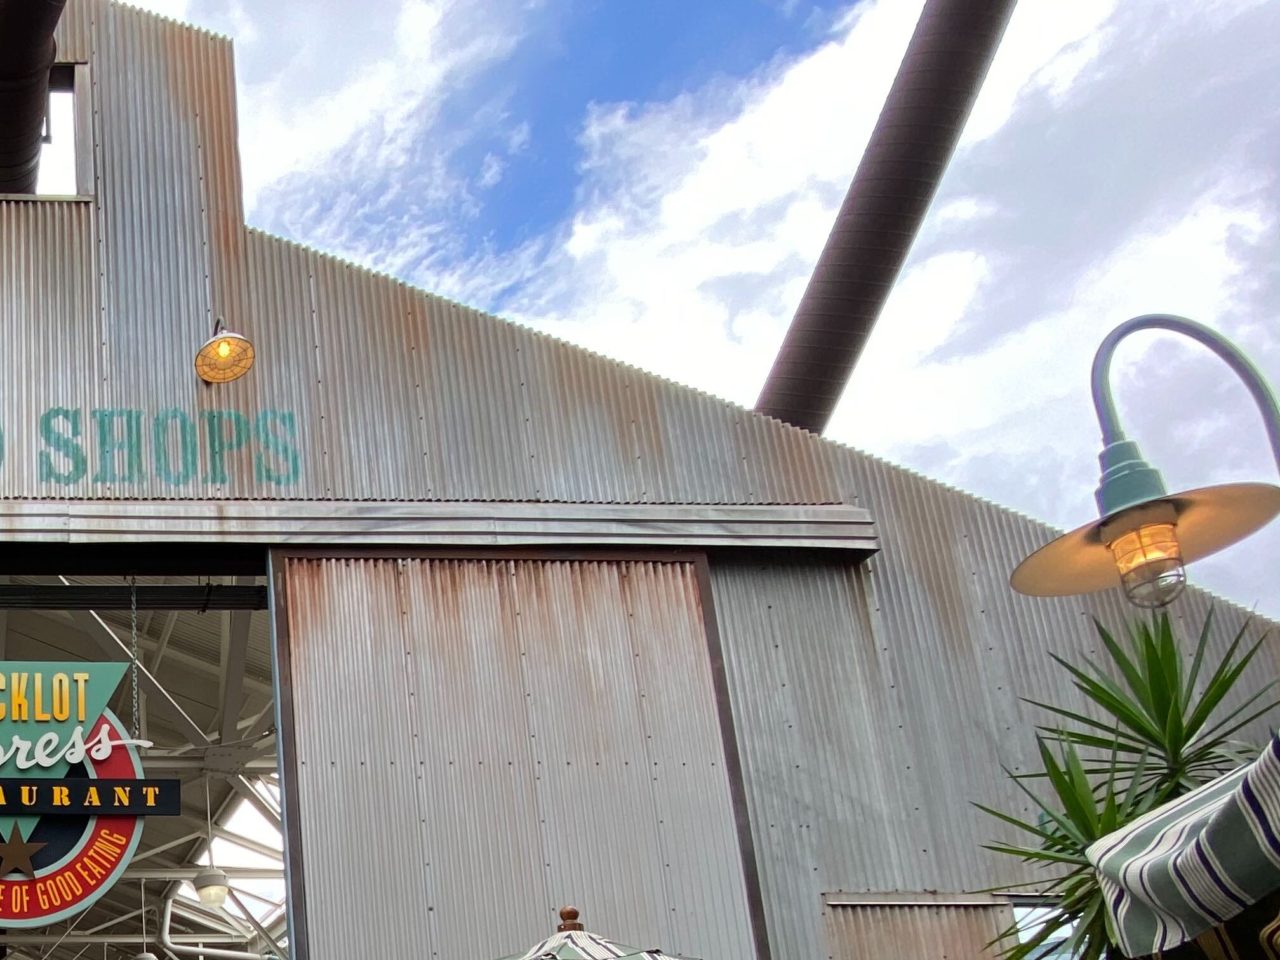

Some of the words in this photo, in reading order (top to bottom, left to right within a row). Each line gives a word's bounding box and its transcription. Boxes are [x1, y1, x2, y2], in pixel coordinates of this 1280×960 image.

[38, 406, 300, 486] SHOPS
[11, 885, 30, 913] OF
[36, 871, 83, 910] GOOD
[75, 829, 127, 886] EATING
